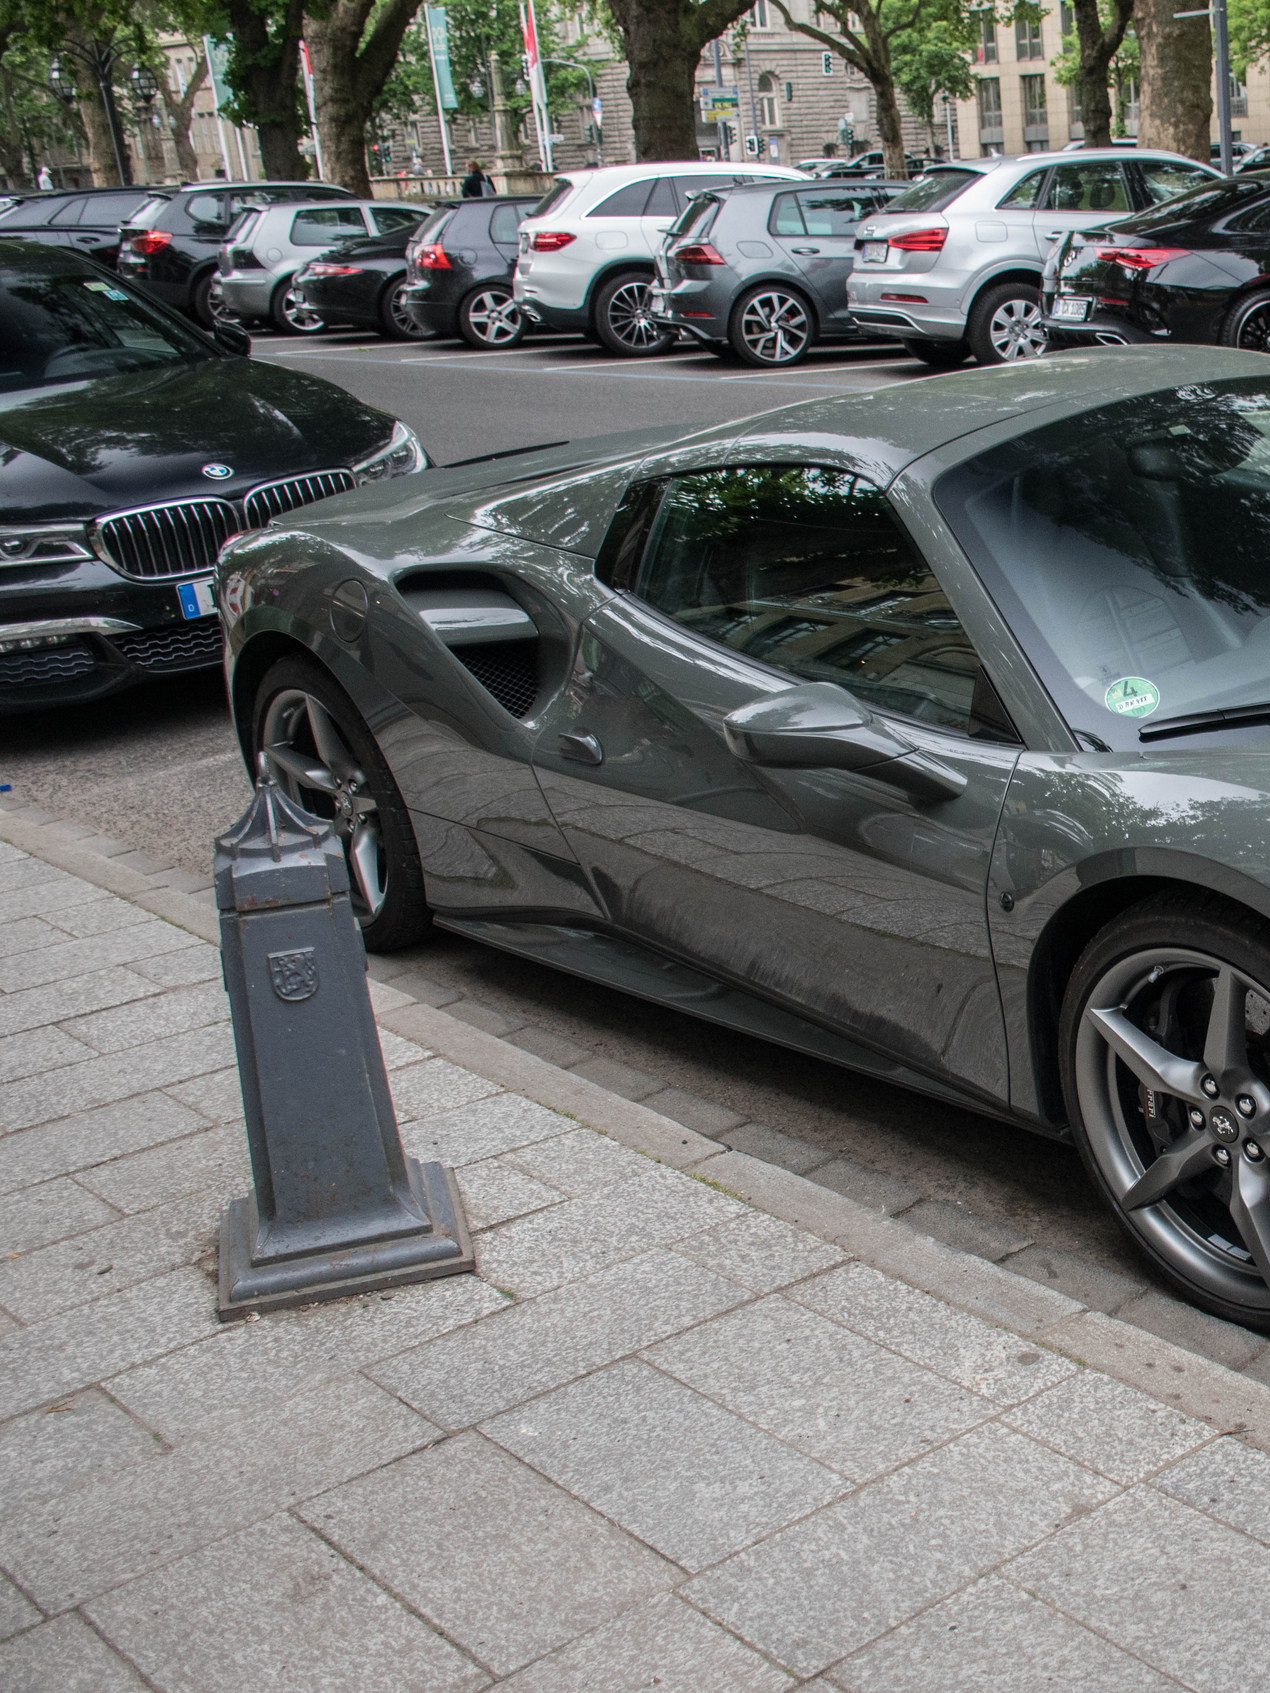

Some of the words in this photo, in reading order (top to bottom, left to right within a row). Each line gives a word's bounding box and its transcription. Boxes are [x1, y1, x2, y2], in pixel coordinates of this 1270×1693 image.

[187, 604, 195, 612] D
[1123, 680, 1138, 697] 4
[1147, 1089, 1156, 1118] rrari
